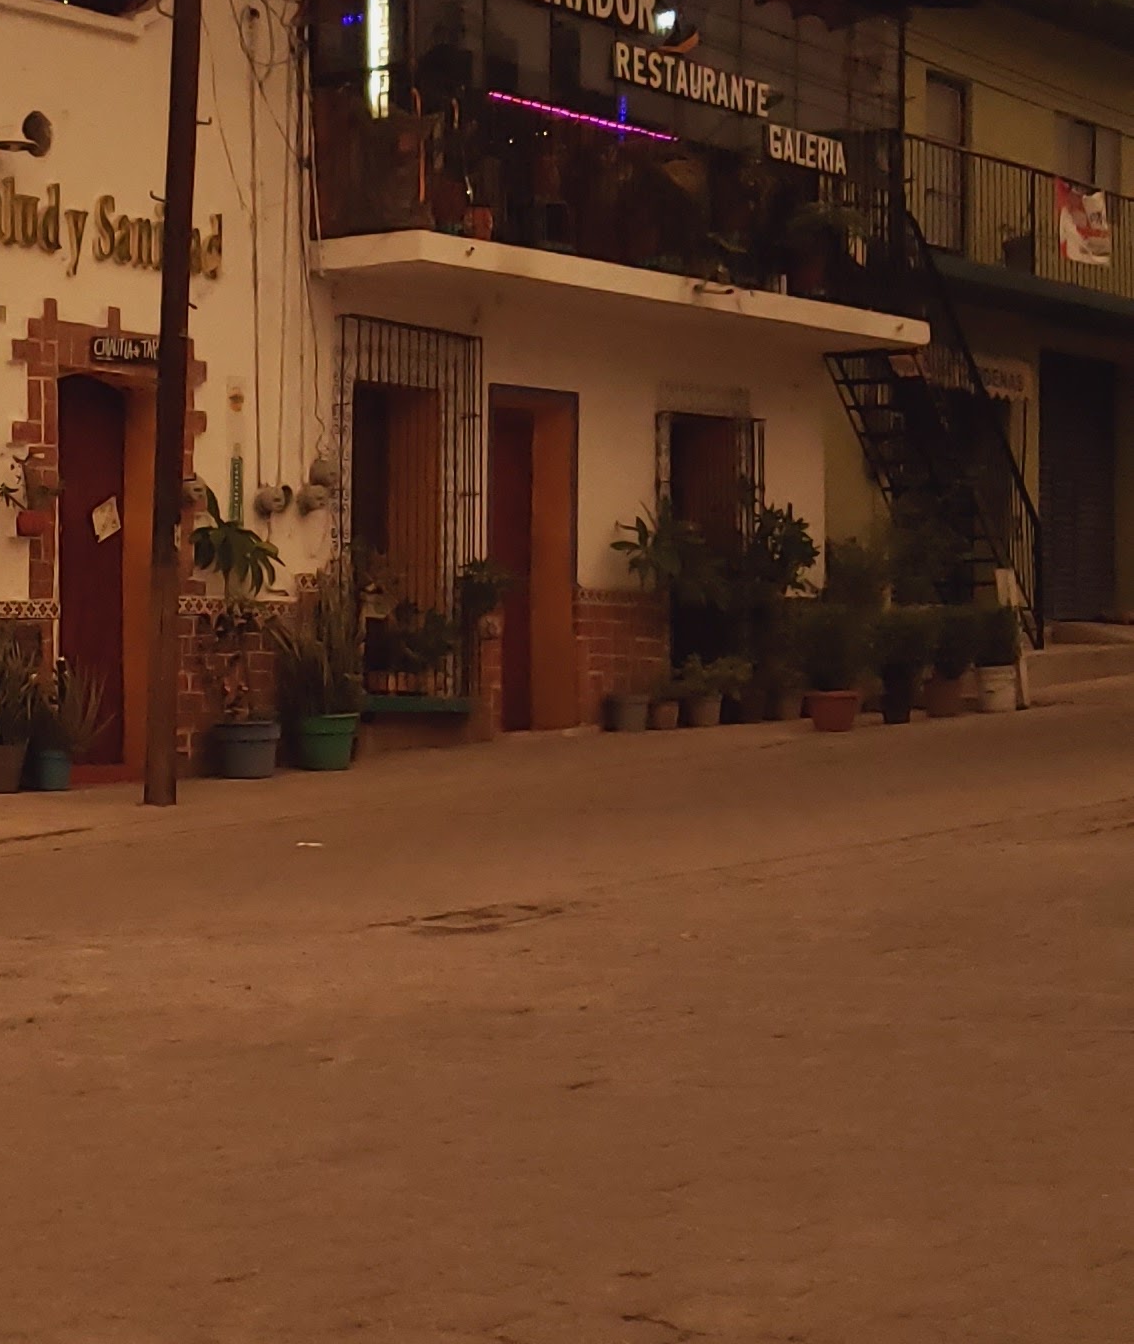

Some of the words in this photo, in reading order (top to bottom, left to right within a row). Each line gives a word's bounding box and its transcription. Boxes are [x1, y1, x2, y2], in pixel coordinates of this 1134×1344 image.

[613, 40, 770, 118] RESTAURANTE
[768, 123, 848, 176] GALERIA
[60, 208, 89, 279] y
[91, 194, 224, 282] Saniad
